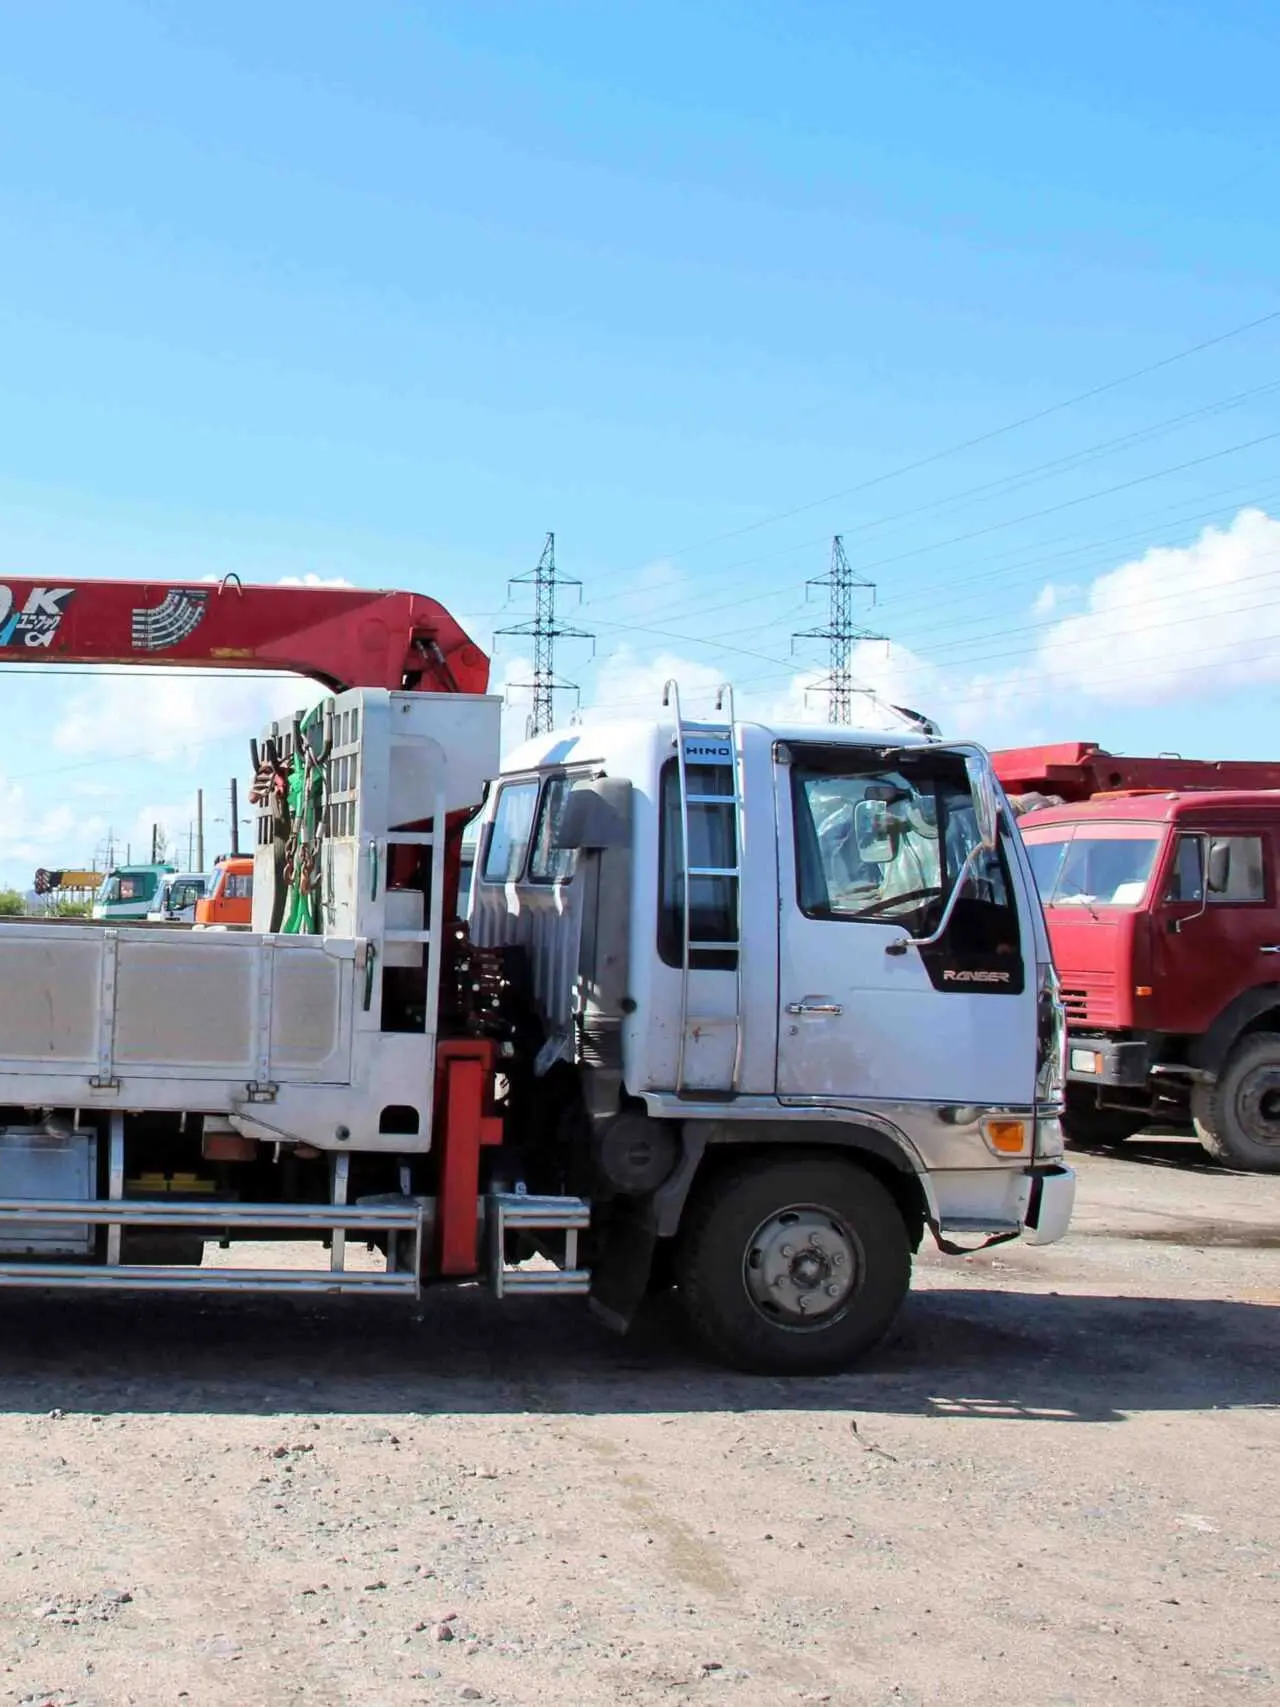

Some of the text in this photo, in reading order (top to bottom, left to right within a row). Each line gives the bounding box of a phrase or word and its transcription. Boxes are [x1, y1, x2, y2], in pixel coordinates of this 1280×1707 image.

[21, 587, 76, 615] K
[686, 747, 730, 756] HINO
[943, 970, 1010, 983] RANGER
